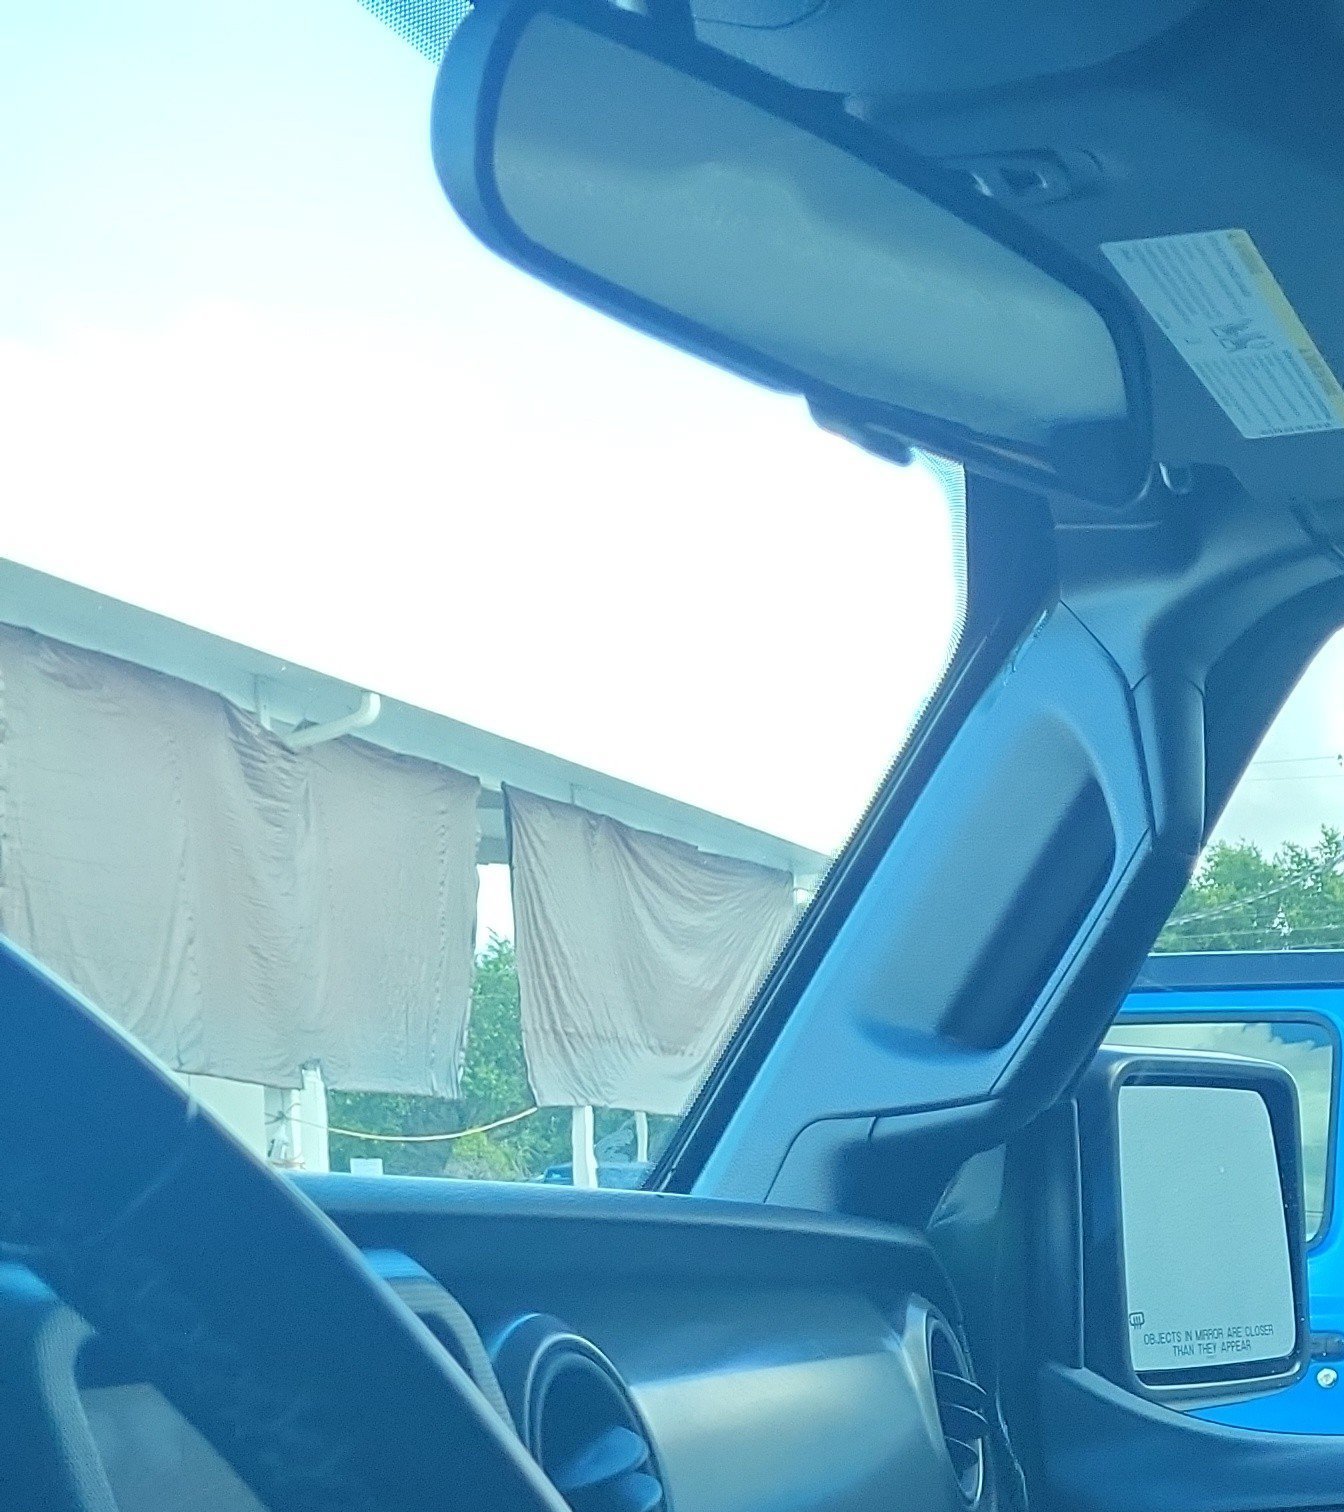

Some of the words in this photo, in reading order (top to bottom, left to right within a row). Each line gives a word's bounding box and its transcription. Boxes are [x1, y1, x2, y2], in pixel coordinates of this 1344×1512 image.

[1143, 1331, 1182, 1345] OBJECTS
[1184, 1330, 1193, 1341] IN
[1195, 1328, 1224, 1341] MIRROR
[1227, 1326, 1242, 1338] ARE
[1245, 1324, 1274, 1337] CLOSER
[1173, 1345, 1194, 1356] THAN
[1198, 1343, 1217, 1354] THEY
[1221, 1340, 1251, 1352] APPEAR
